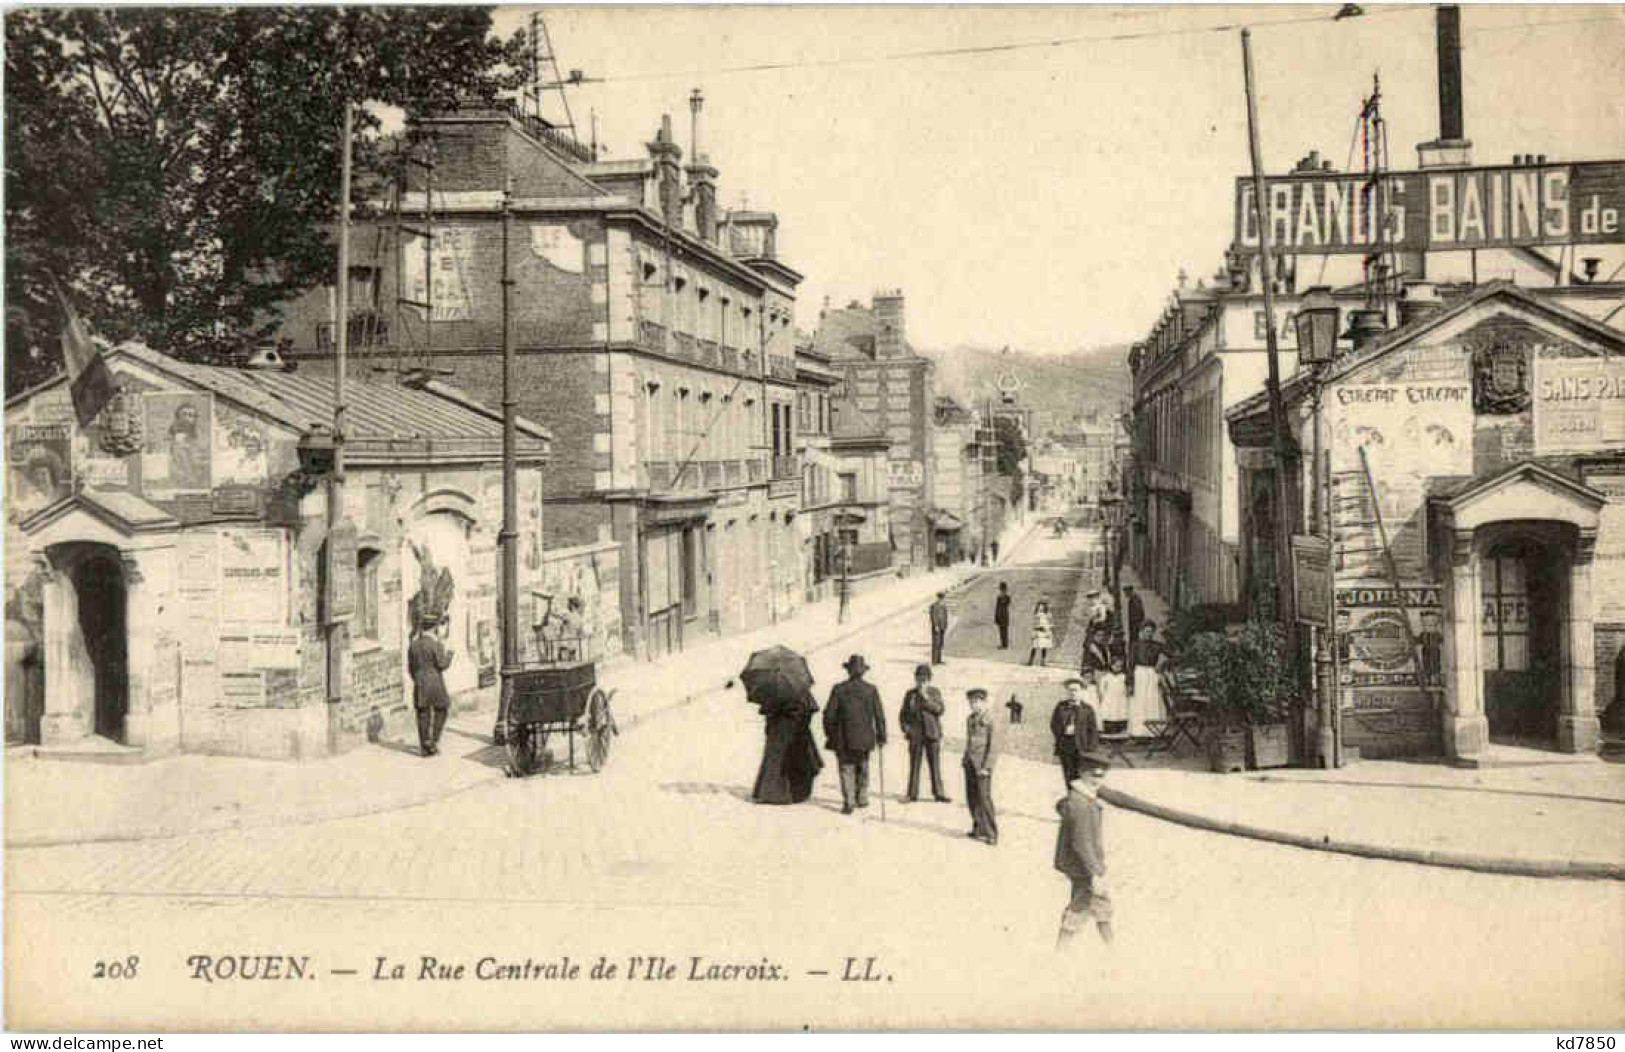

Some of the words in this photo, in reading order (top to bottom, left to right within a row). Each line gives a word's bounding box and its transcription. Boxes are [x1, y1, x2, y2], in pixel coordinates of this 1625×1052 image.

[1240, 178, 1406, 247] GRANDS
[1428, 166, 1571, 243] BAINS
[1580, 193, 1619, 235] de
[1542, 375, 1591, 402] SANS
